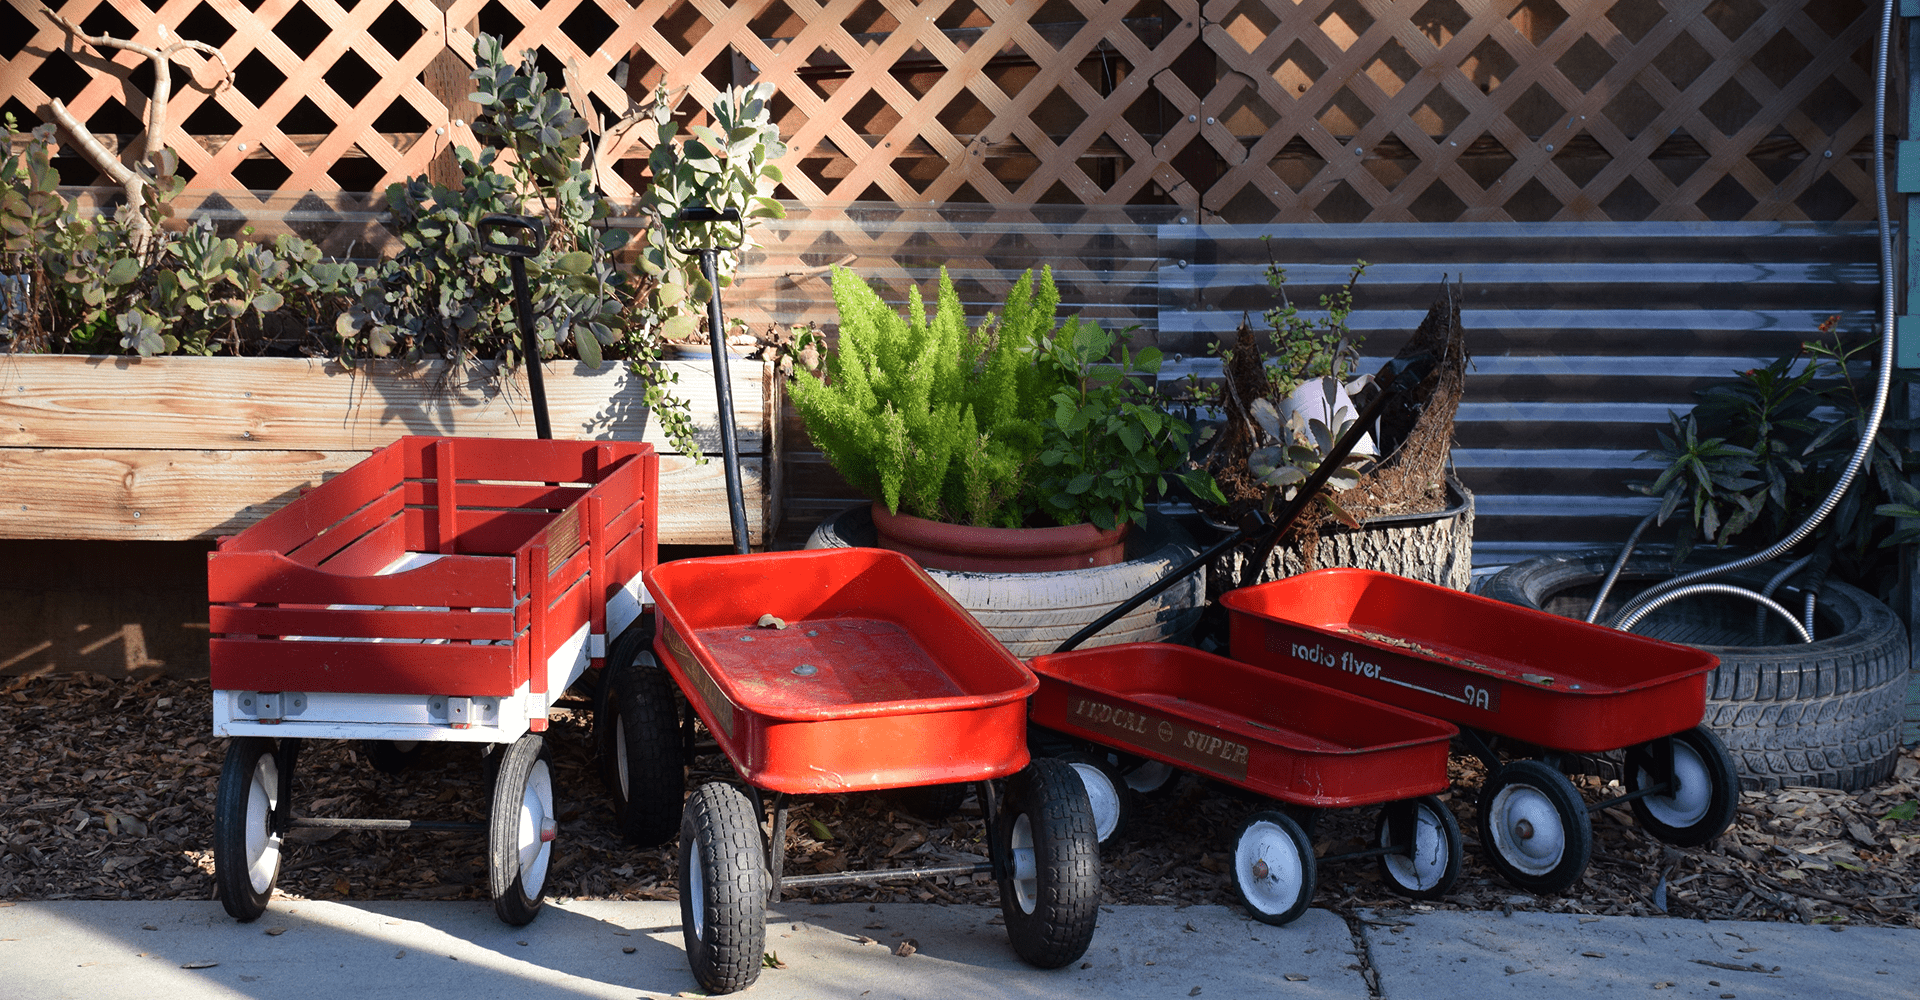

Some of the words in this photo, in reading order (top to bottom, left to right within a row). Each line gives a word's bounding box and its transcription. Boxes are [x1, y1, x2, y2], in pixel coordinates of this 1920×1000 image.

[1291, 642, 1336, 668] radio
[1341, 651, 1382, 680] flyer
[1463, 684, 1490, 710] 9A
[1182, 729, 1250, 765] SUPER
